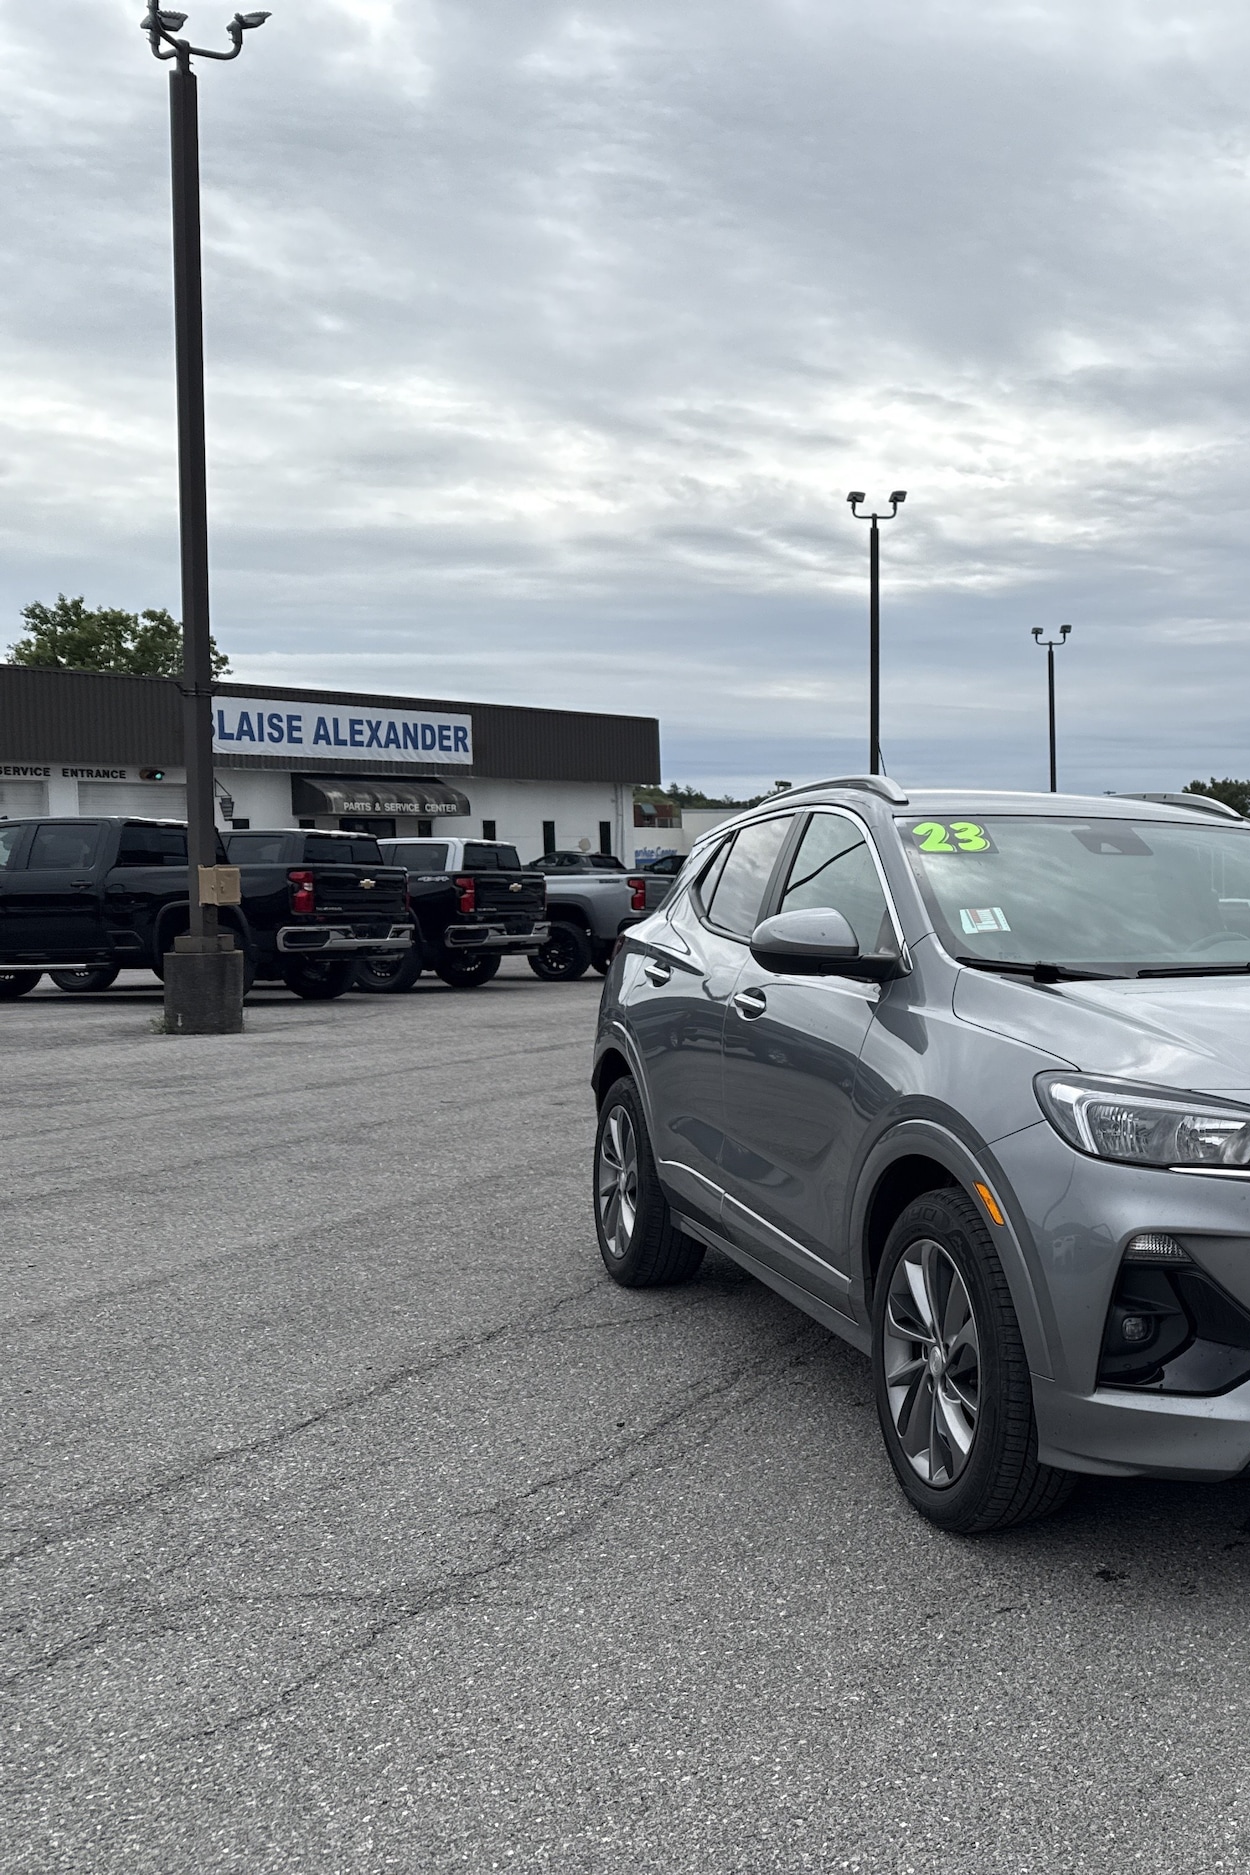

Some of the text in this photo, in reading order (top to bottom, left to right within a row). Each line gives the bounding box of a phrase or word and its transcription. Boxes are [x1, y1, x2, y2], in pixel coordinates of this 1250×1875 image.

[211, 709, 470, 753] LAISE ALEXANDER
[62, 768, 126, 779] ENTRANCE
[343, 802, 457, 813] PARTS & SERVICE CENTER
[912, 821, 991, 852] 23
